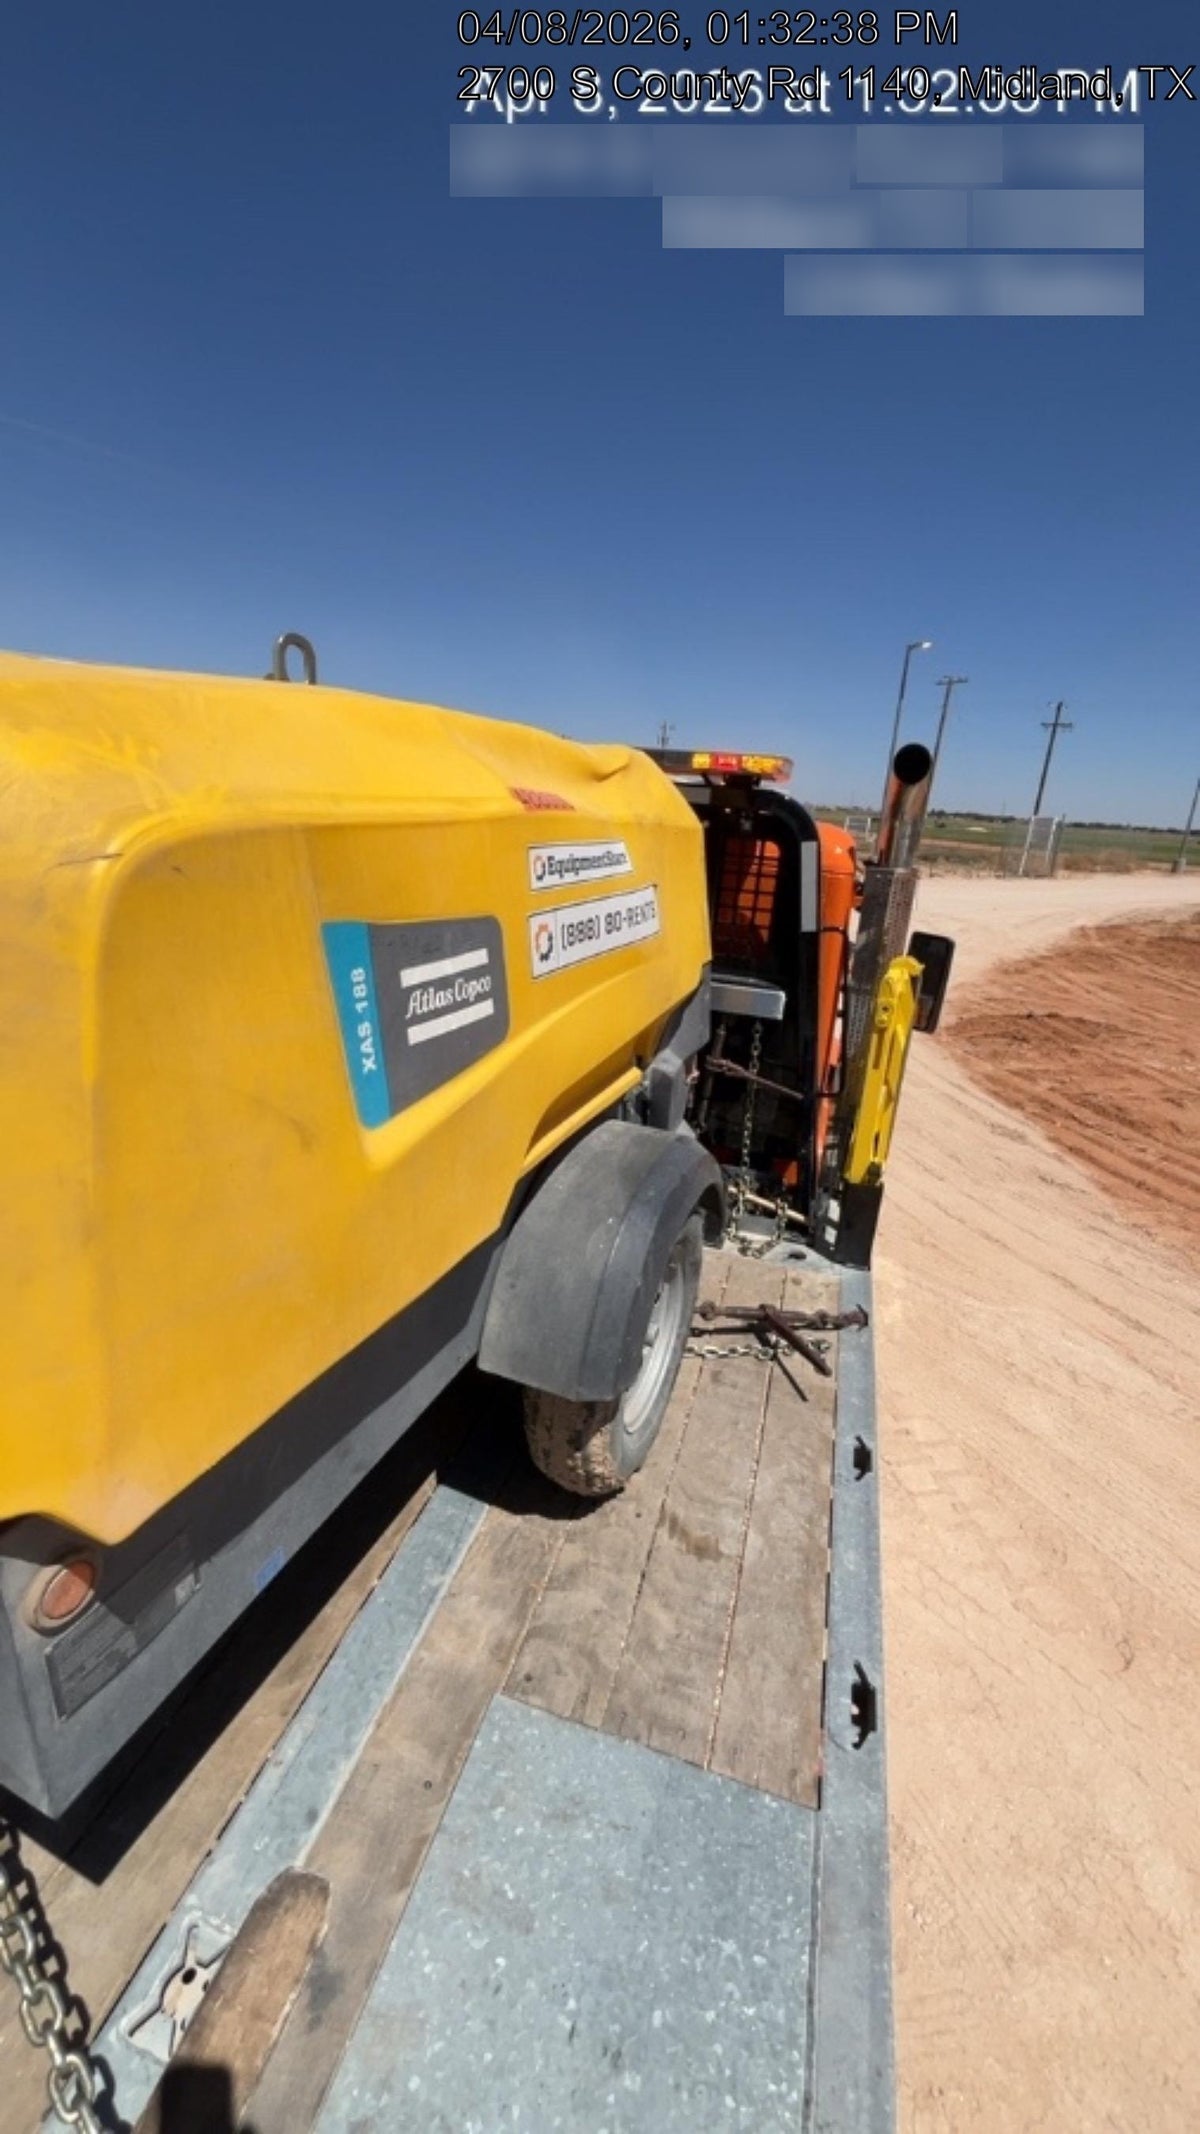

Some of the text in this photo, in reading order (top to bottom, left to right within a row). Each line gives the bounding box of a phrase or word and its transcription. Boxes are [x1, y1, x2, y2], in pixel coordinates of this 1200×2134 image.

[561, 914, 600, 950] (888)
[405, 975, 492, 1020] Atlas Copco
[351, 967, 377, 1075] XAS 188
